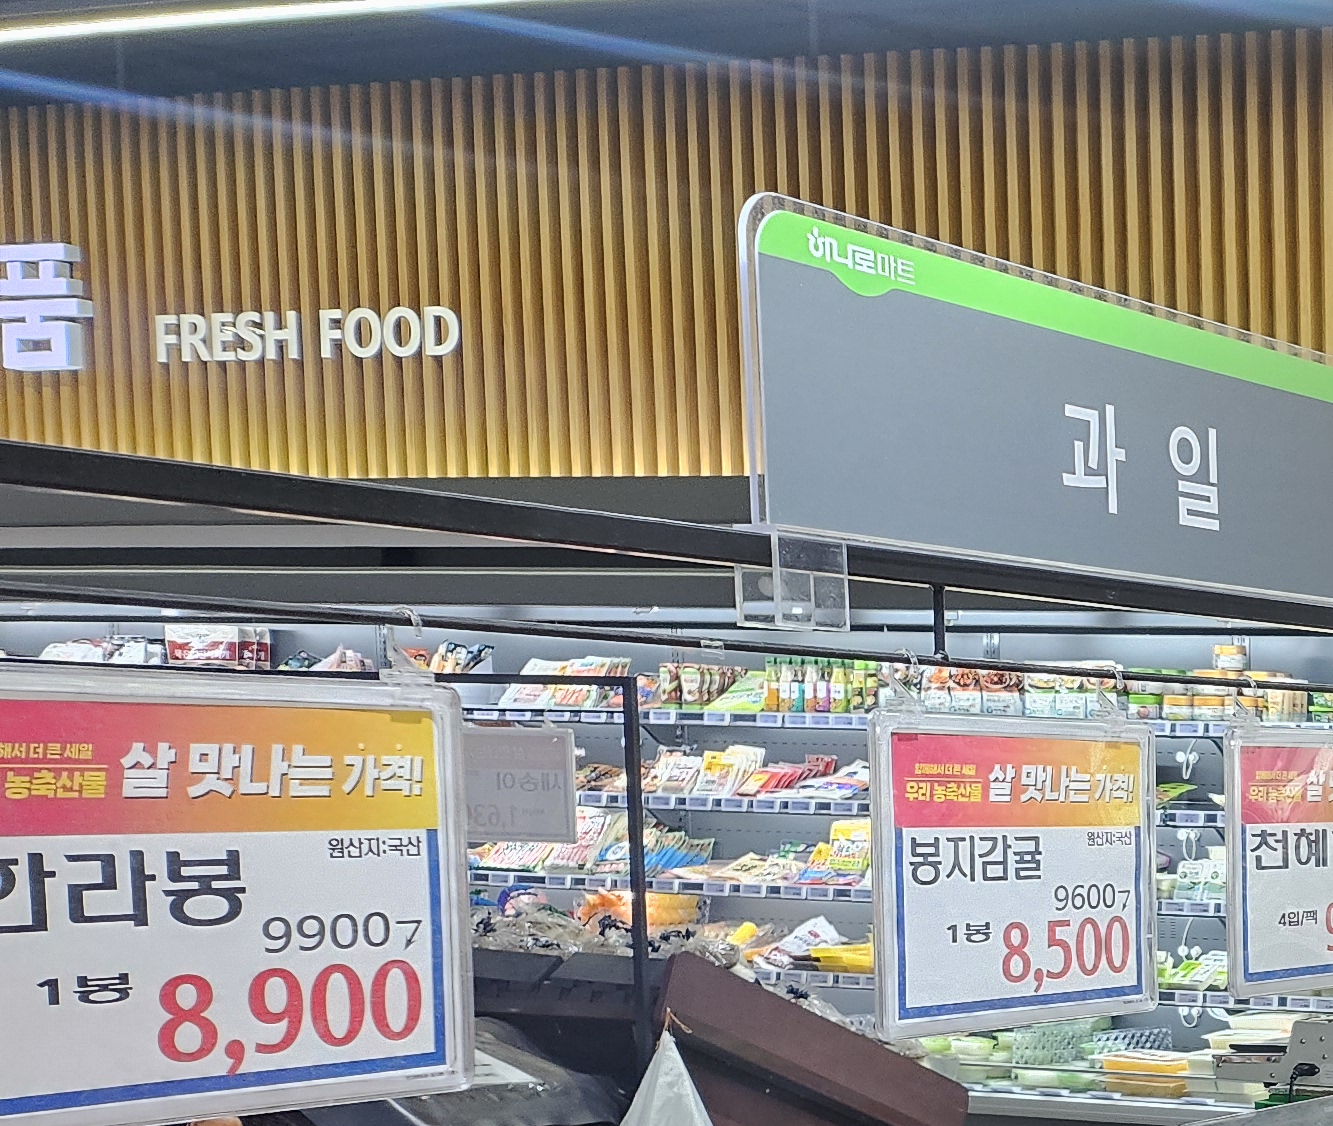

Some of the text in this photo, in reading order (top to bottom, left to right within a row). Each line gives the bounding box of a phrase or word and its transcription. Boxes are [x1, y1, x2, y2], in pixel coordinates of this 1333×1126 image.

[806, 226, 916, 286] 하나로마트
[0, 242, 93, 371] 품
[155, 305, 461, 363] FRESH FOOD
[5, 741, 424, 799] 농축산물 살 맛나는 가격!
[30, 743, 44, 759] 더
[46, 743, 62, 759] 큰
[64, 742, 93, 759] 세일
[905, 763, 1136, 804] 우리 농축산물 살 맛나는 가격!
[1248, 786, 1267, 803] 우리
[1306, 770, 1326, 803] 살
[328, 836, 423, 859] 원산지:국산
[909, 835, 1043, 886] 봉지감귤
[1087, 830, 1132, 847] 원산지:국산
[1278, 908, 1318, 928] 4입/팩
[945, 915, 1131, 994] 1봉 8,500
[36, 959, 423, 1077] 1봉 8,900
